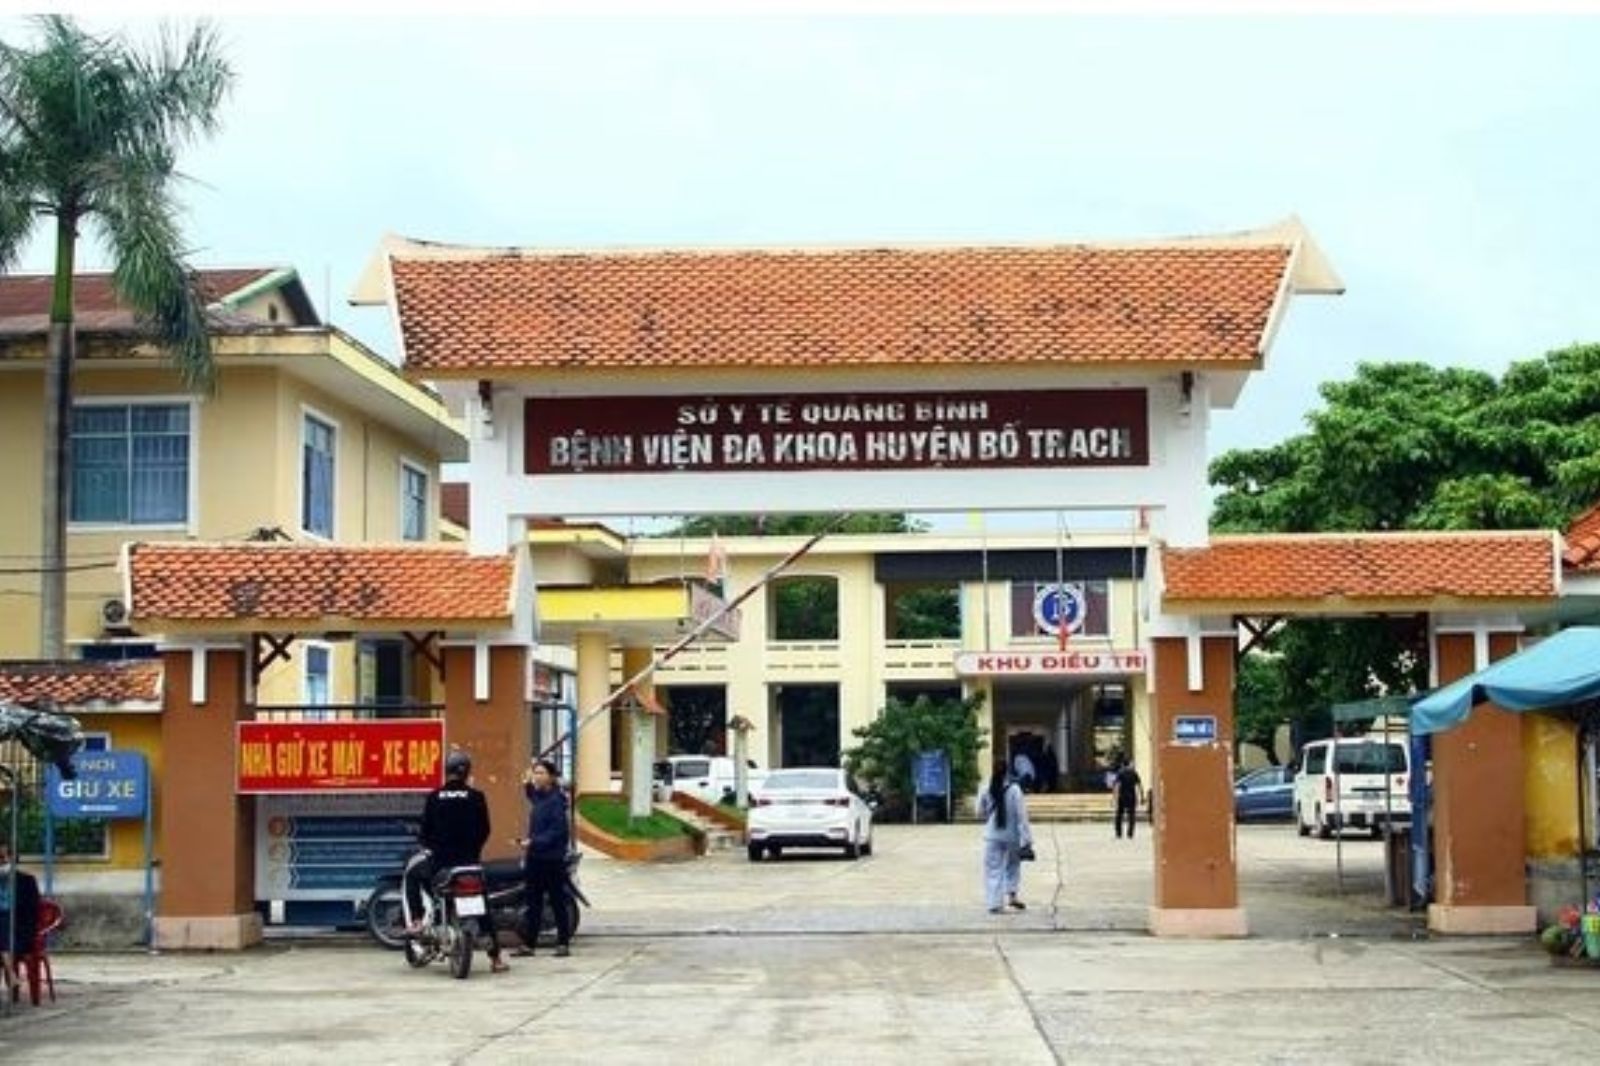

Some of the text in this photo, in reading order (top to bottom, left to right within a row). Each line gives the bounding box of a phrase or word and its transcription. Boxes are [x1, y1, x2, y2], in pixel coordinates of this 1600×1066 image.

[730, 403, 746, 424] Y
[550, 429, 632, 472] BỆNH
[642, 428, 713, 470] VIỆN
[722, 433, 765, 464] ĐA
[773, 431, 858, 463] KHOA
[865, 425, 971, 467] HUYỆN
[978, 656, 1032, 670] KHU
[307, 740, 328, 776] XE
[383, 740, 404, 776] XE
[107, 779, 136, 799] XE
